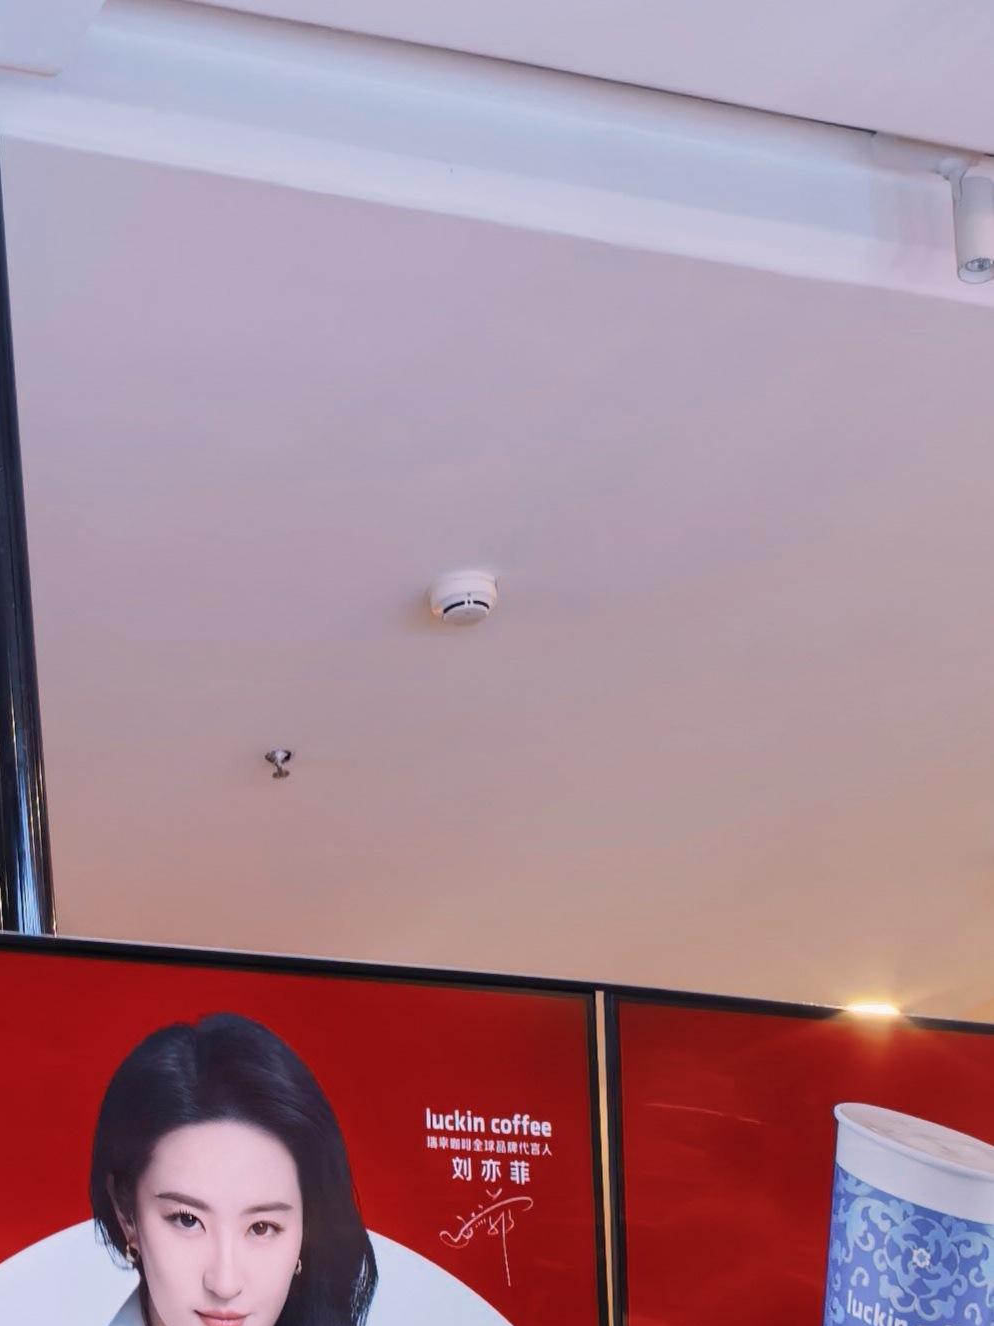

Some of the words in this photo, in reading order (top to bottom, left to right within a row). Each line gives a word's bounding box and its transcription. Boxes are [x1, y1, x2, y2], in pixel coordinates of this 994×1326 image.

[425, 1107, 486, 1133] luckin
[490, 1114, 552, 1137] coffee
[451, 1156, 531, 1185] 刘亦菲
